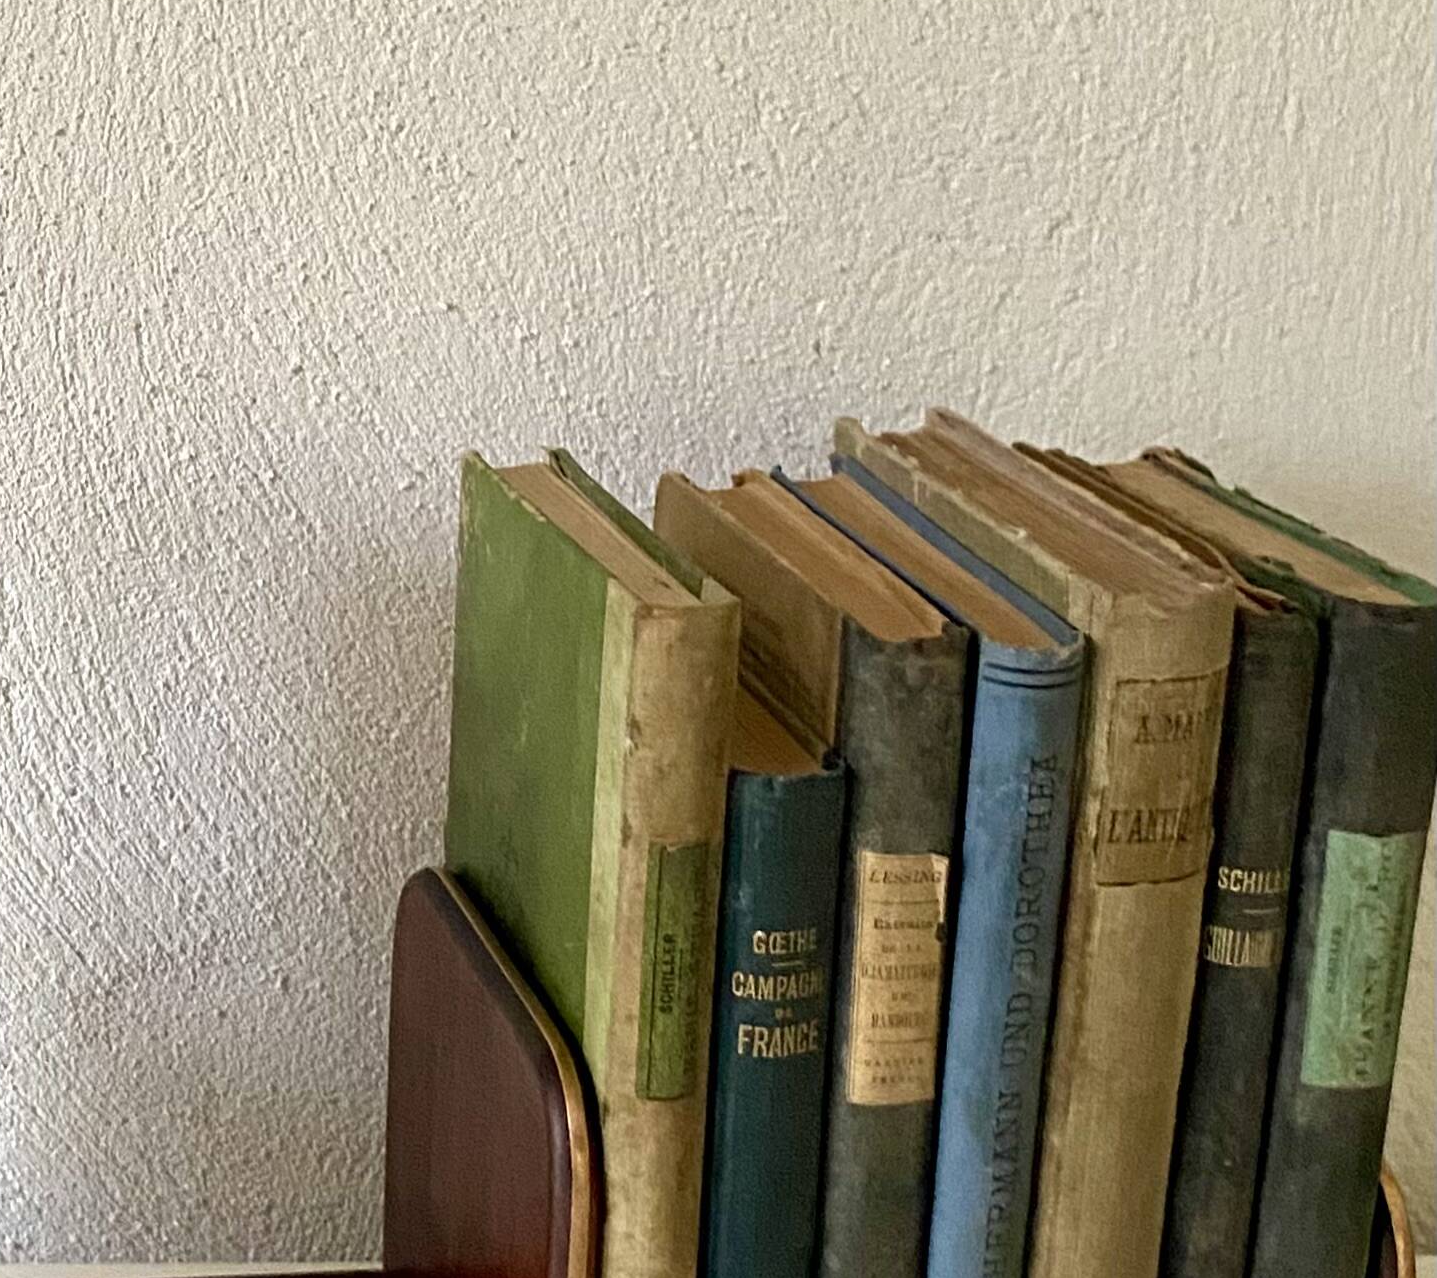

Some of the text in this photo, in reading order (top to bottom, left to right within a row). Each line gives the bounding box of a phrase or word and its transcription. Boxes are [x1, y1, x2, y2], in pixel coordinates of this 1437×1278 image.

[869, 869, 943, 884] LESSING
[1010, 753, 1058, 974] DOROTHEA
[658, 932, 677, 1015] SCHILLER
[737, 1019, 820, 1058] FRANCE
[999, 992, 1033, 1071] UND
[982, 1090, 1023, 1278] HERMANN
